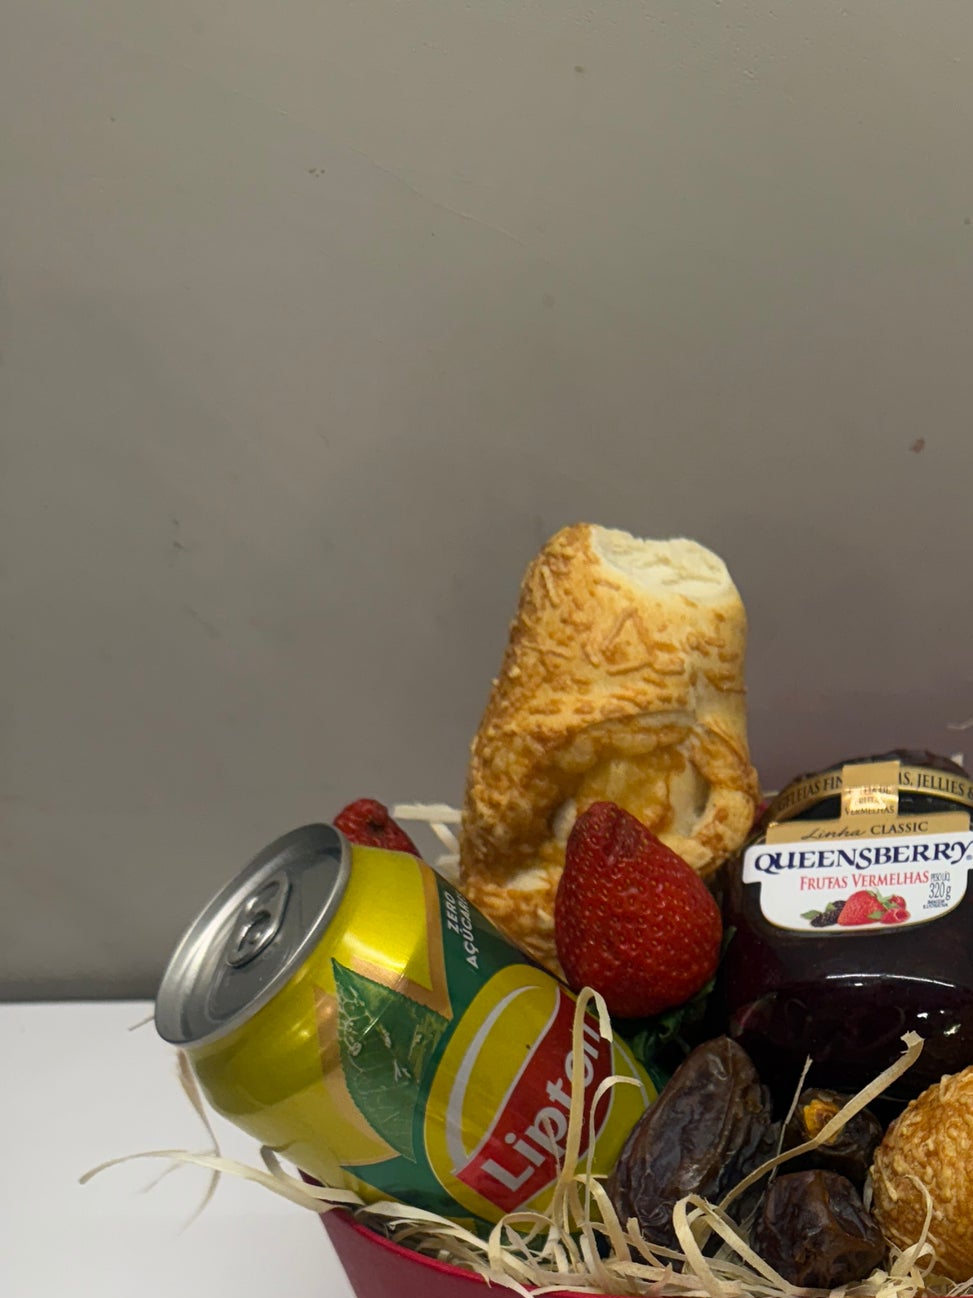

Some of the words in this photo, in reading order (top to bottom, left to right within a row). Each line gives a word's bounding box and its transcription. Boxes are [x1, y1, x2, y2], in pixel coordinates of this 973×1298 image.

[916, 774, 965, 796] JELLIES
[870, 821, 929, 836] CLASSIC
[800, 874, 848, 891] FRUTAS
[852, 870, 929, 888] VERMELHAS
[444, 891, 460, 934] ZERO
